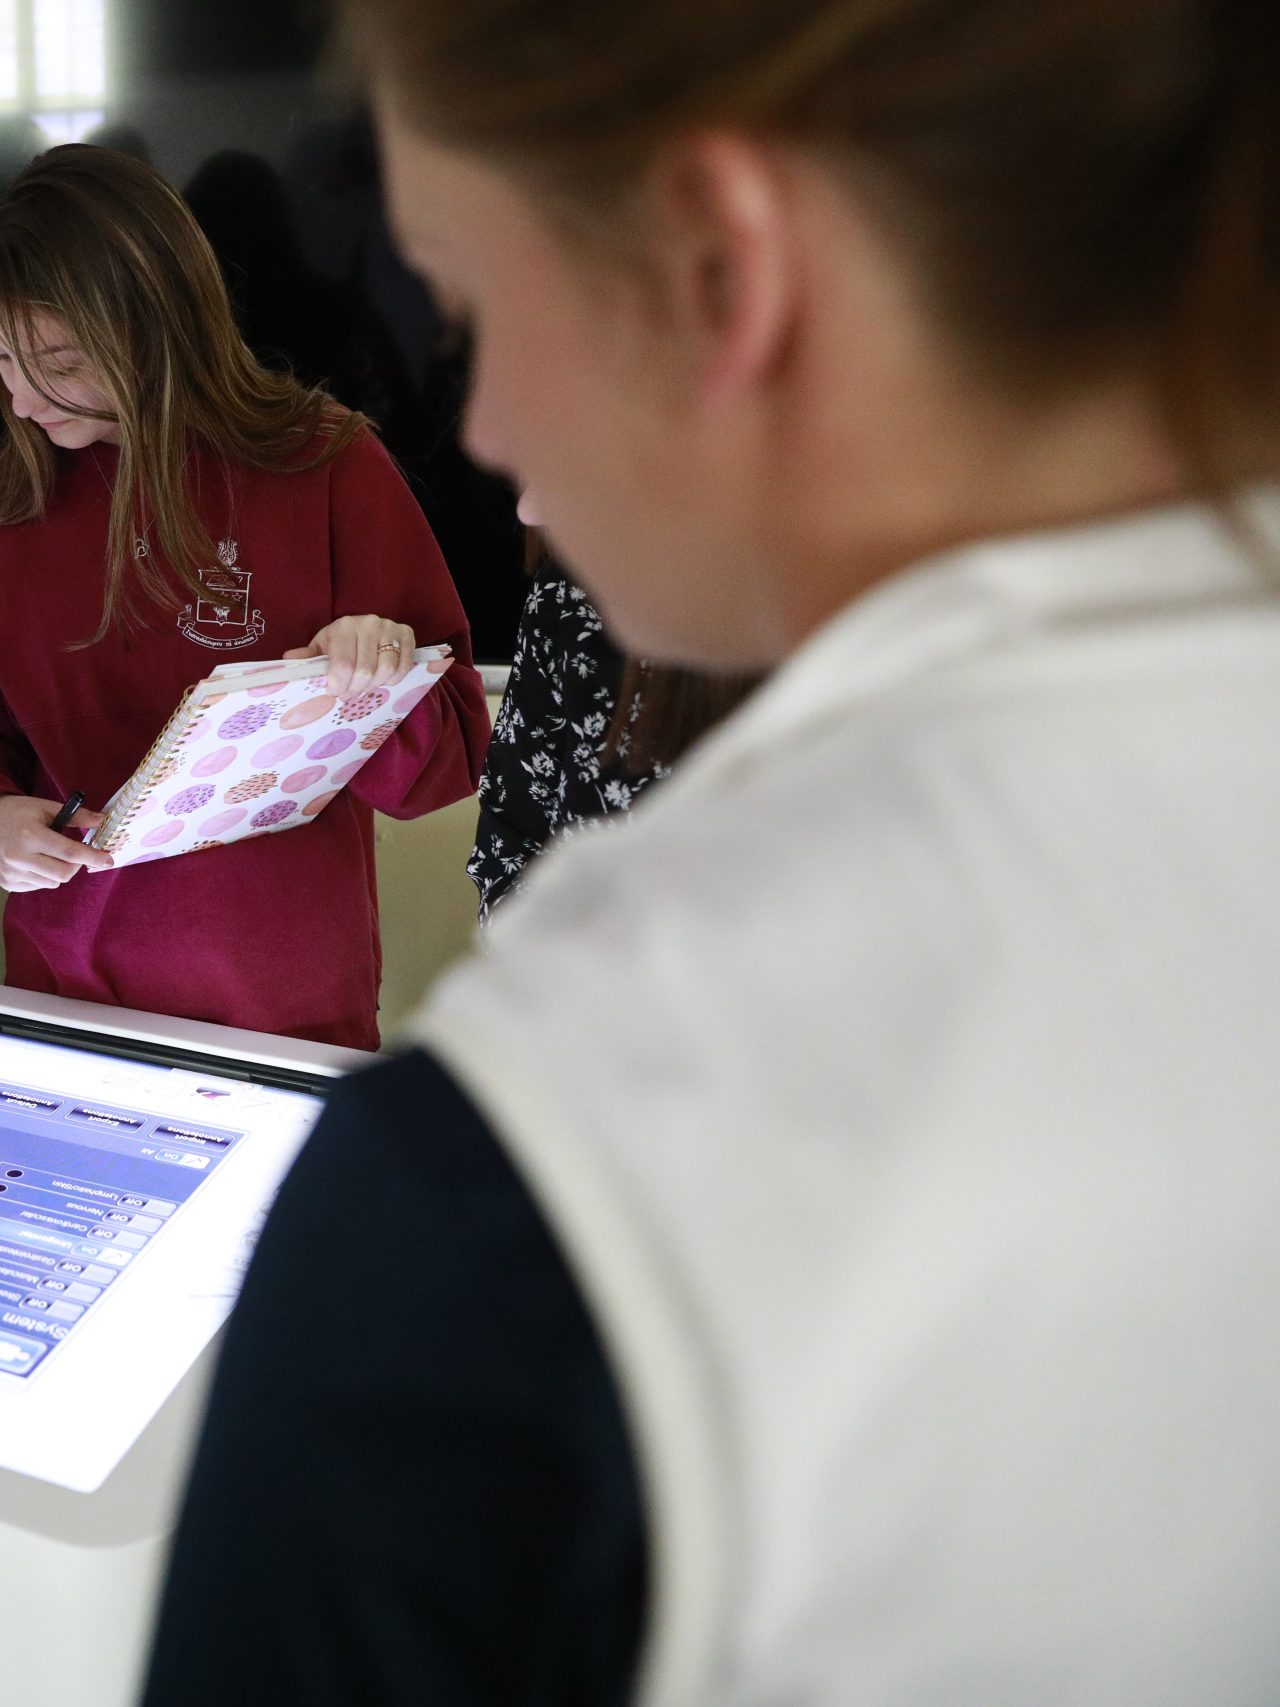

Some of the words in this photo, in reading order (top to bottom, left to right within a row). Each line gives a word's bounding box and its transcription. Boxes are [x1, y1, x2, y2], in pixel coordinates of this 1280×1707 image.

[2, 1091, 54, 1106] Annotations
[5, 1098, 37, 1108] Default
[82, 1109, 137, 1124] Annotations
[88, 1116, 119, 1126] Export
[167, 1127, 224, 1142] Annotations
[174, 1134, 206, 1144] Import
[164, 1152, 178, 1160] On
[52, 1180, 118, 1200] Lymphatic/Skin
[124, 1198, 142, 1206] Off
[66, 1202, 103, 1216] Nervous
[20, 1210, 87, 1231] Cardiovascular
[111, 1214, 128, 1222] Off
[94, 1229, 112, 1238] Off
[82, 1246, 98, 1255] On
[62, 1262, 81, 1272] Off
[45, 1280, 64, 1290] Off
[27, 1298, 48, 1309] Off
[2, 1312, 68, 1340] System
